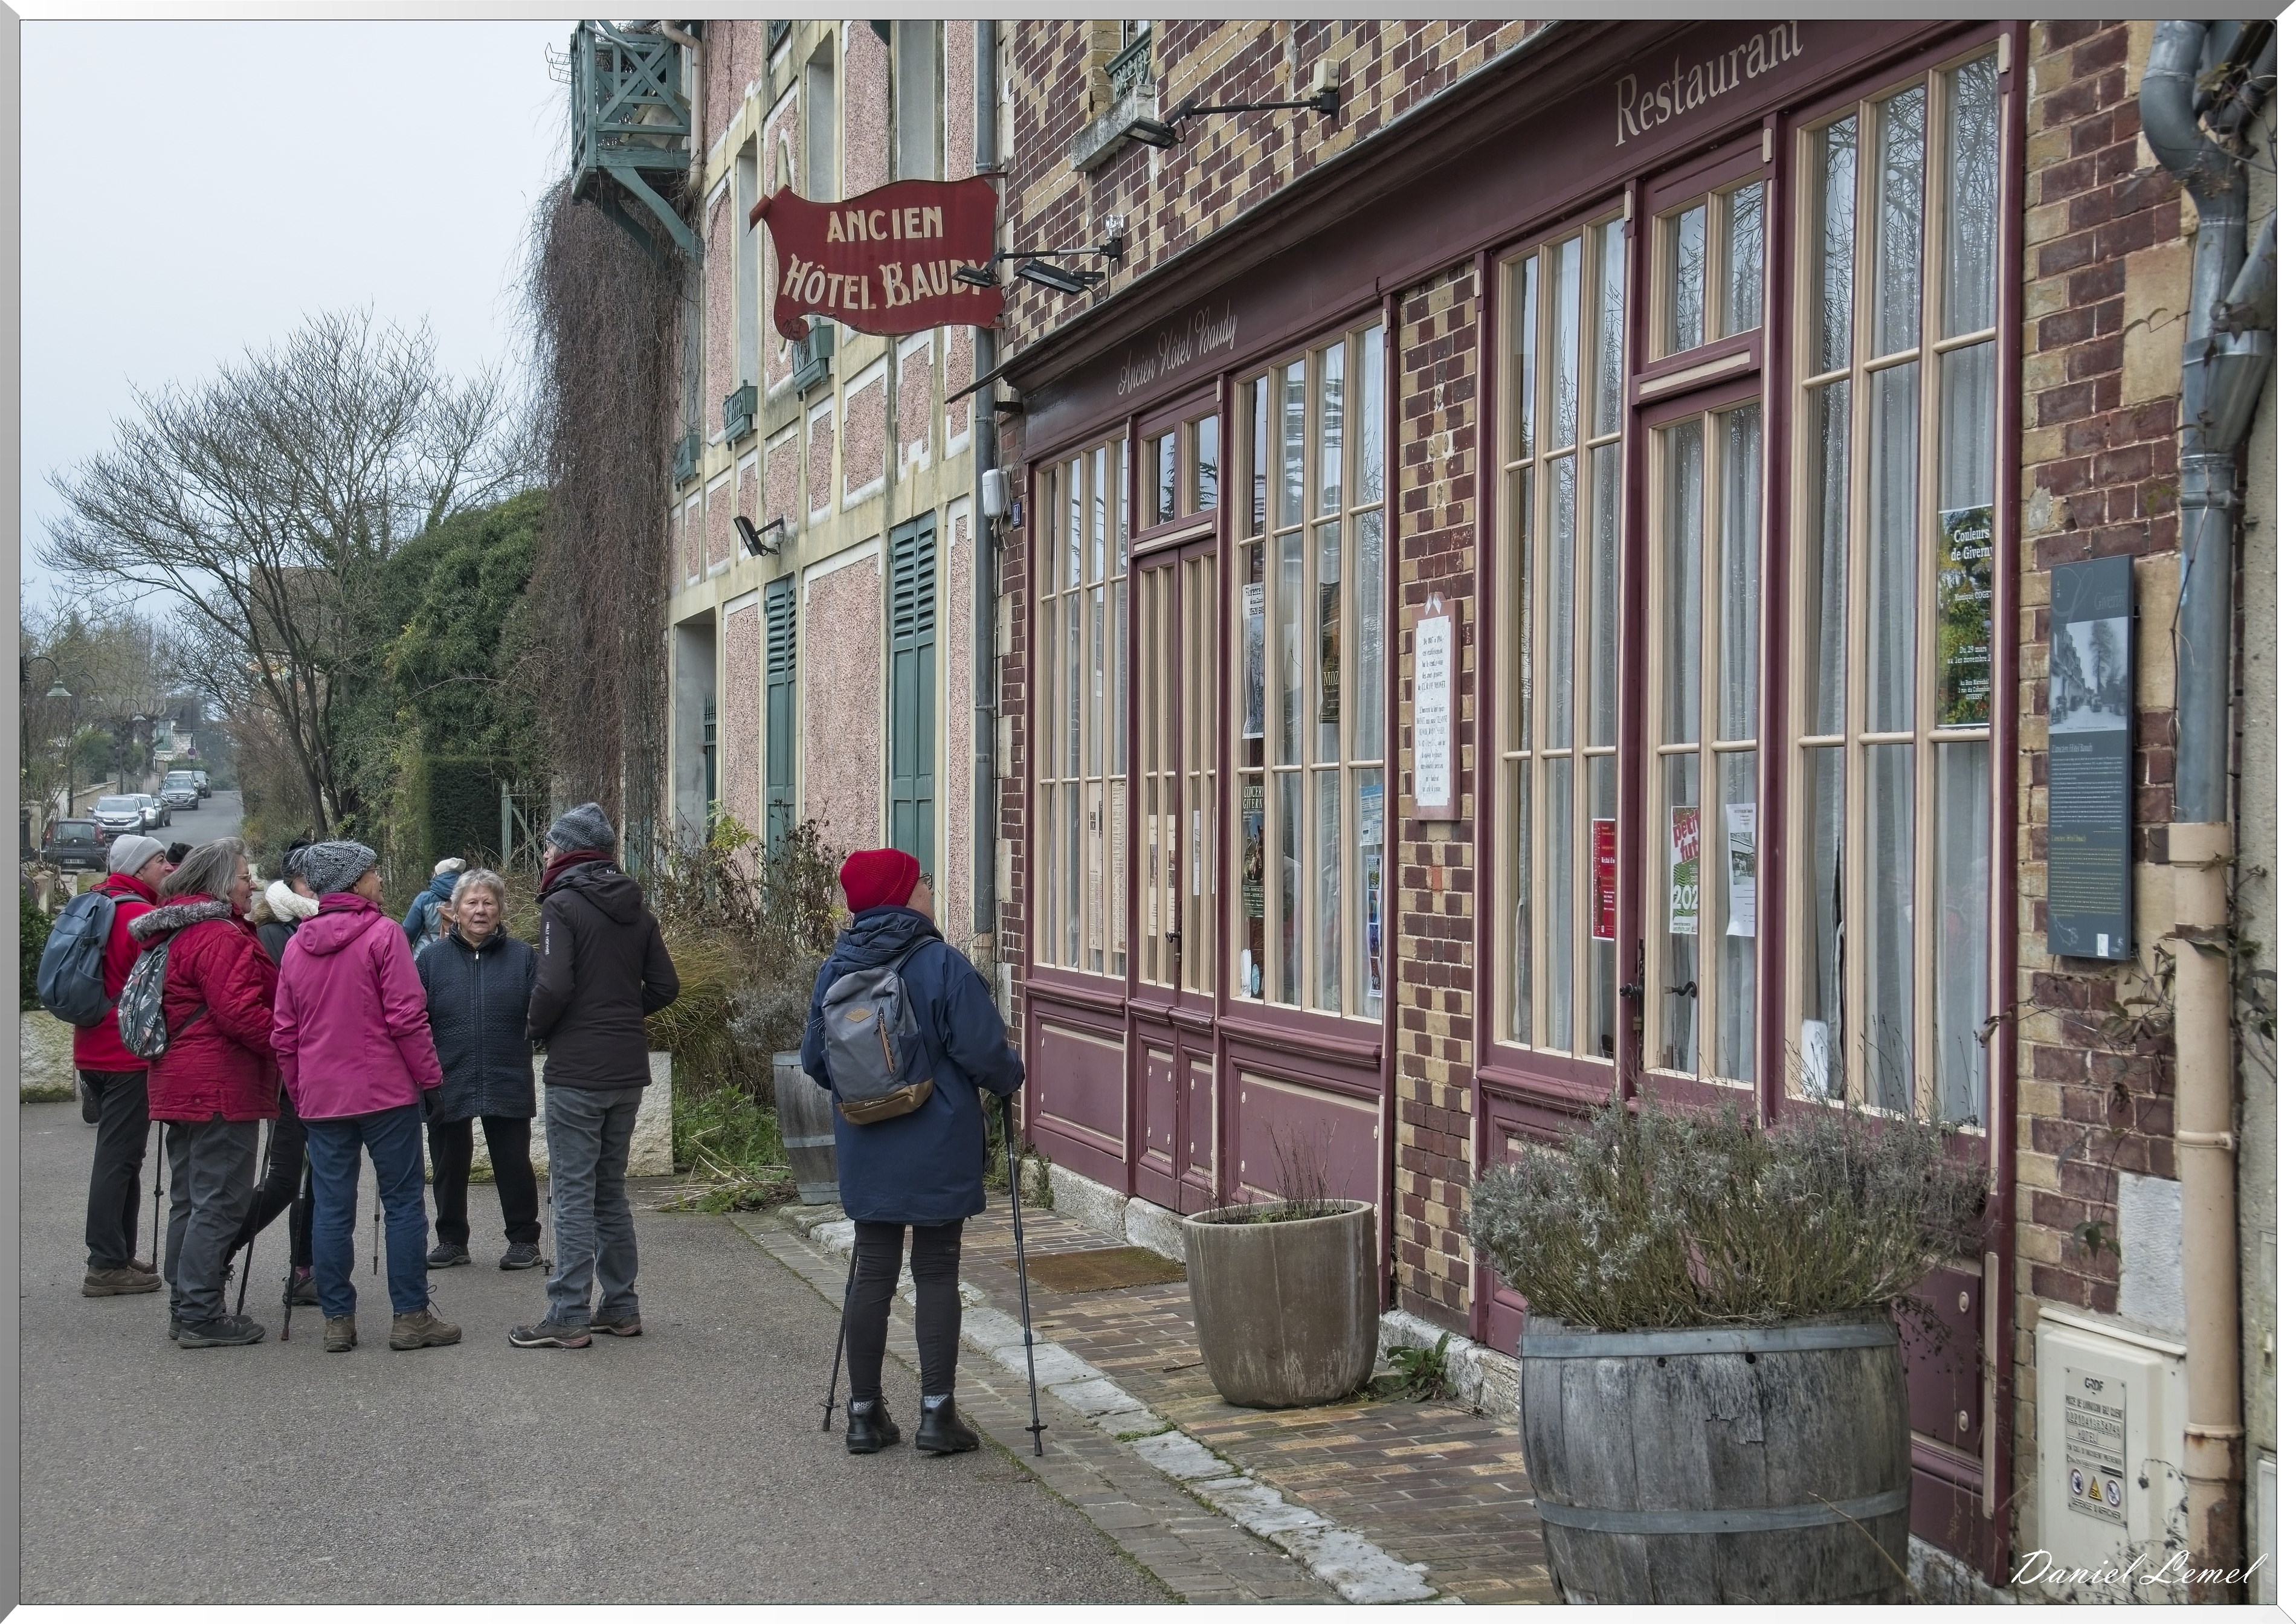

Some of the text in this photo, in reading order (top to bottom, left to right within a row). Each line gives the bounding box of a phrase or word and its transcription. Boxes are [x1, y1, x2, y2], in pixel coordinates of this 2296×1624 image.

[1614, 20, 1804, 147] Restaurant
[825, 206, 944, 243] ANCIEN
[781, 253, 877, 310] HÔTEL
[1118, 299, 1238, 396] Ancien Hôtel Baudy
[1953, 527, 1990, 543] Couleurs
[1951, 547, 1961, 561] de
[1245, 587, 1261, 596] Florence
[1323, 671, 1339, 686] MOZ
[1672, 884, 1698, 909] 202
